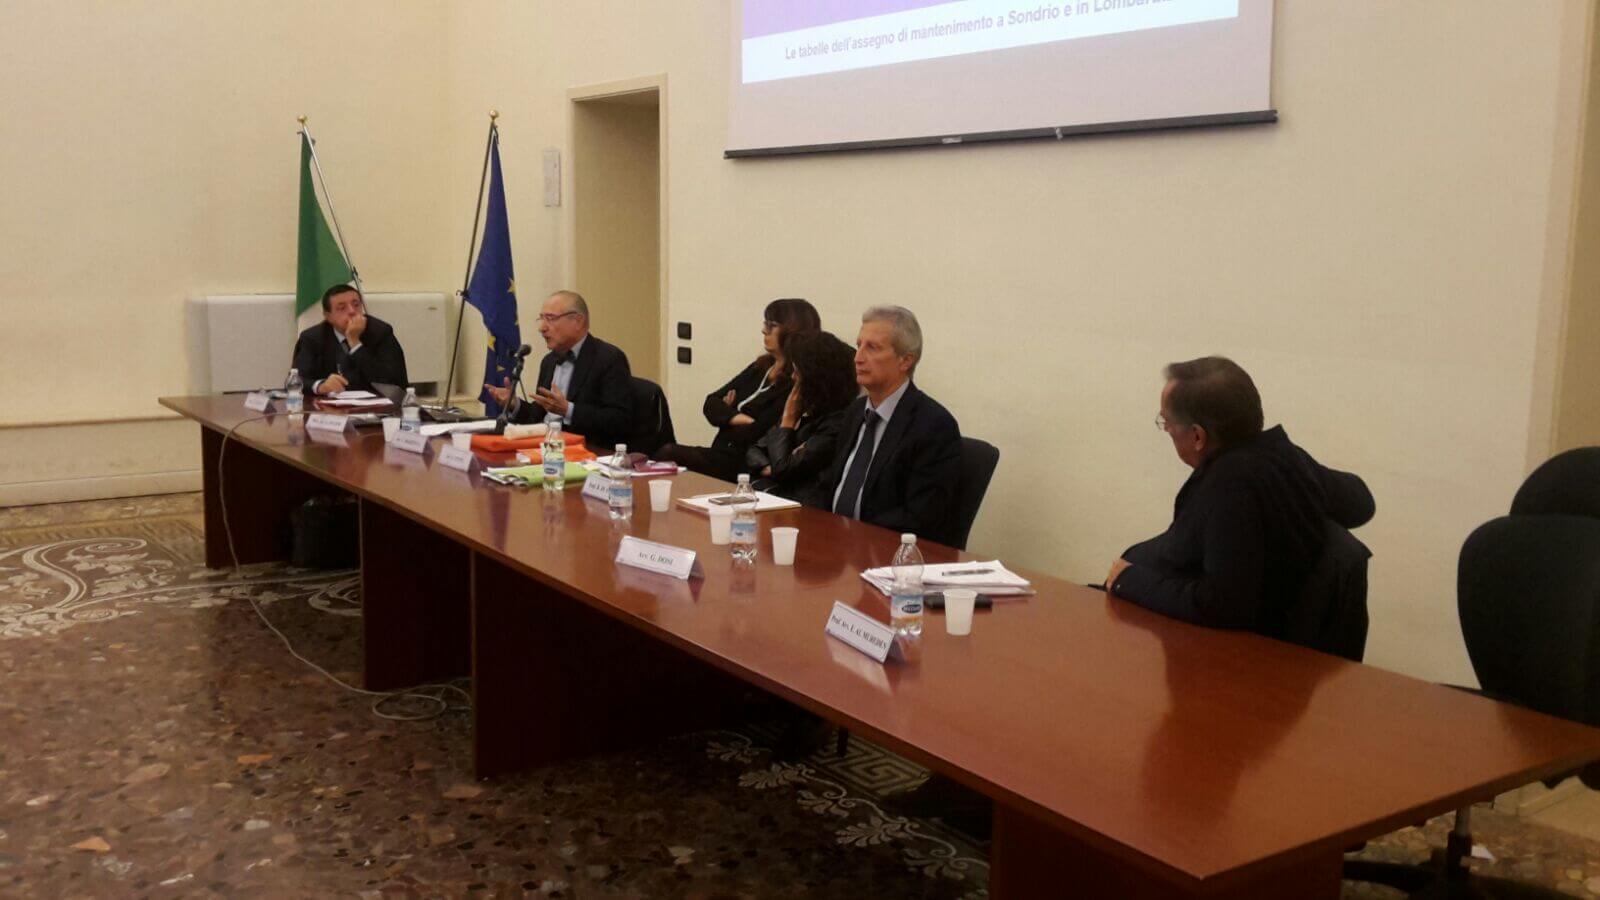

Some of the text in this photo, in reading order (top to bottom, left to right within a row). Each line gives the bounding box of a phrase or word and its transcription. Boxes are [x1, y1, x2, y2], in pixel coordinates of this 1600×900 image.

[799, 40, 830, 58] tabelle
[898, 27, 908, 42] di
[911, 16, 993, 41] mantenimento
[996, 15, 1004, 28] a
[1008, 4, 1060, 25] Sondrio
[1063, 4, 1072, 17] e
[1077, 0, 1089, 15] in
